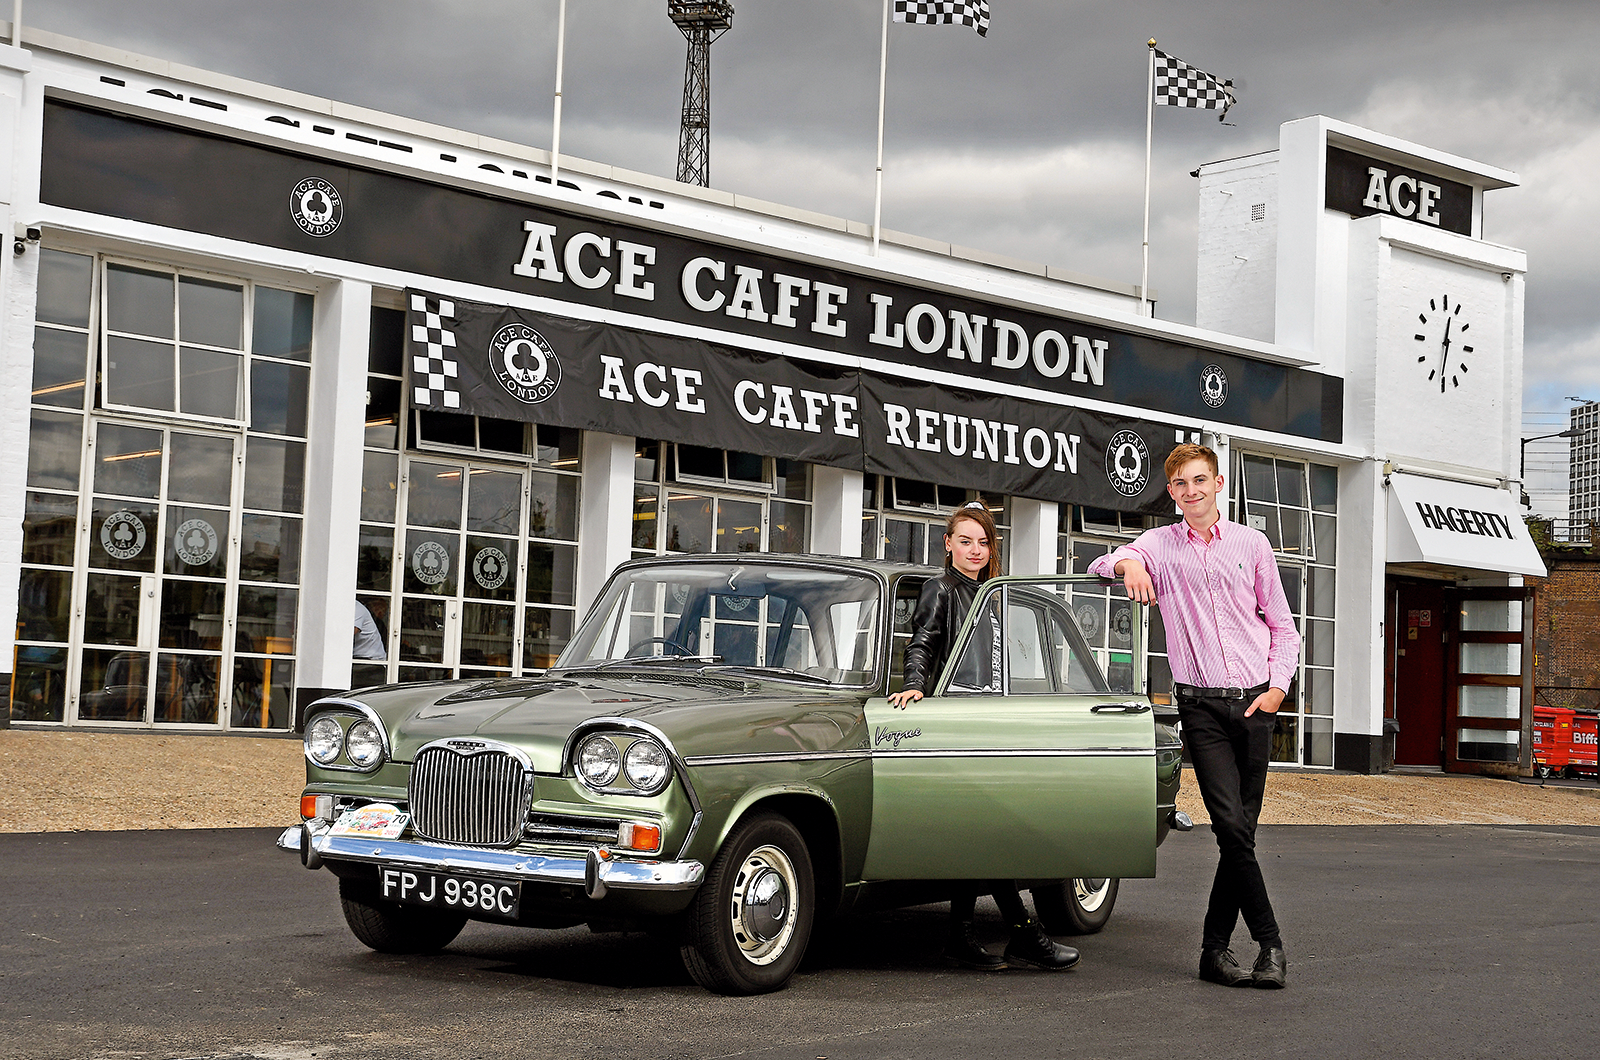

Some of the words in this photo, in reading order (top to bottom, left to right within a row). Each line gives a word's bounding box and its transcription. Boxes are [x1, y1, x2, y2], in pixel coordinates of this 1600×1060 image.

[295, 180, 315, 200] ACE
[317, 181, 340, 207] CAFE
[1363, 166, 1441, 226] ACE
[295, 210, 337, 234] LONDON
[513, 219, 657, 301] ACE
[681, 257, 848, 338] CAFE
[868, 293, 1109, 386] LONDON
[494, 327, 518, 353] ACE
[521, 328, 554, 360] CAFE
[499, 370, 555, 400] LONDON
[515, 373, 538, 382] ACE
[1203, 390, 1225, 406] LONDON
[599, 354, 706, 414] ACE
[733, 379, 860, 438] CAFE
[883, 402, 1081, 475] REUNION
[1110, 433, 1126, 455] ACE
[1127, 433, 1148, 460] CAFE
[1110, 470, 1146, 494] LONDON
[104, 514, 121, 531] ACE
[123, 513, 144, 534] CAFE
[178, 521, 194, 538] ACE
[196, 520, 216, 541] CAFE
[1415, 501, 1514, 540] HAGERTY
[104, 540, 142, 558] LONDON
[177, 547, 213, 564] LONDON
[415, 543, 430, 559] ACE
[431, 543, 448, 562] CAFE
[475, 548, 489, 564] ACE
[490, 548, 507, 567] CAFE
[475, 572, 505, 588] LONDON
[874, 726, 922, 747] Vogue
[392, 814, 408, 824] 70
[383, 869, 436, 902] FPJ
[444, 878, 514, 914] 938C
